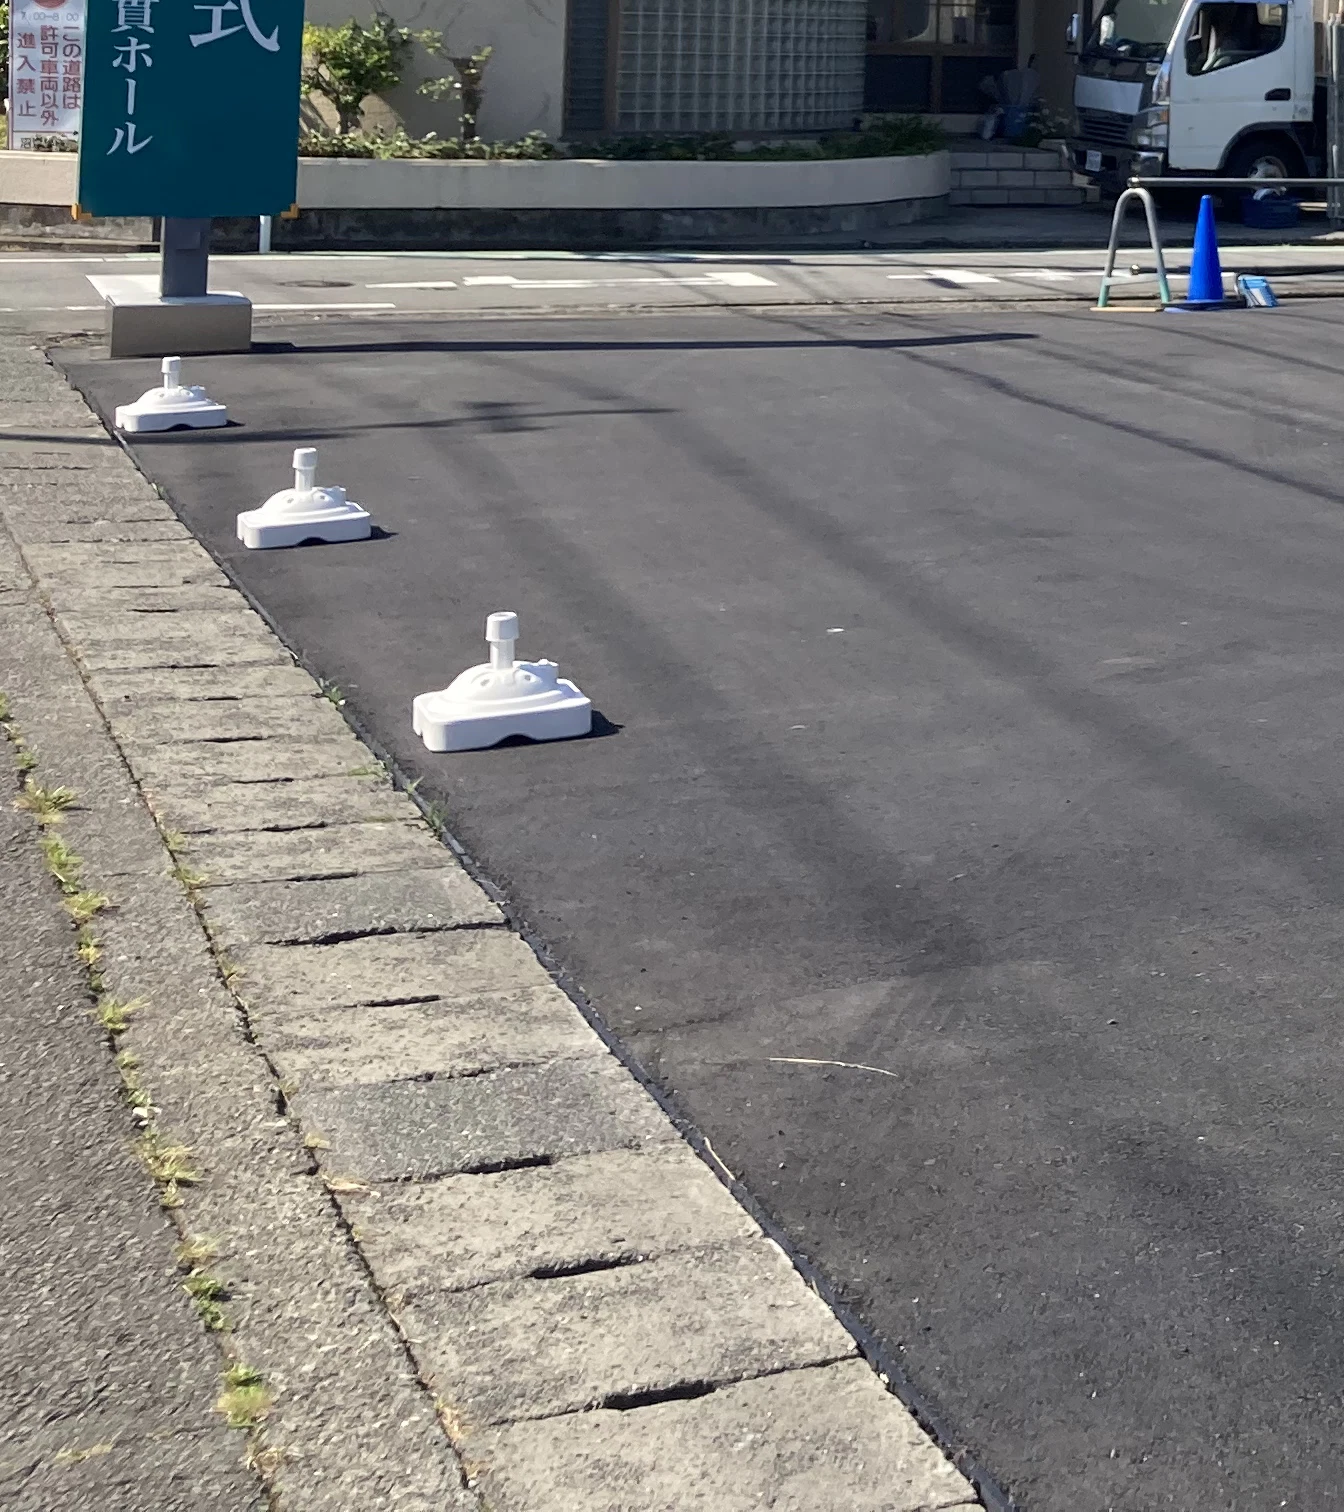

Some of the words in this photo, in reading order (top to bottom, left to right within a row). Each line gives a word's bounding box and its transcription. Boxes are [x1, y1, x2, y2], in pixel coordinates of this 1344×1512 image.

[16, 32, 37, 117] 進入禁止
[62, 25, 82, 110] この道路は
